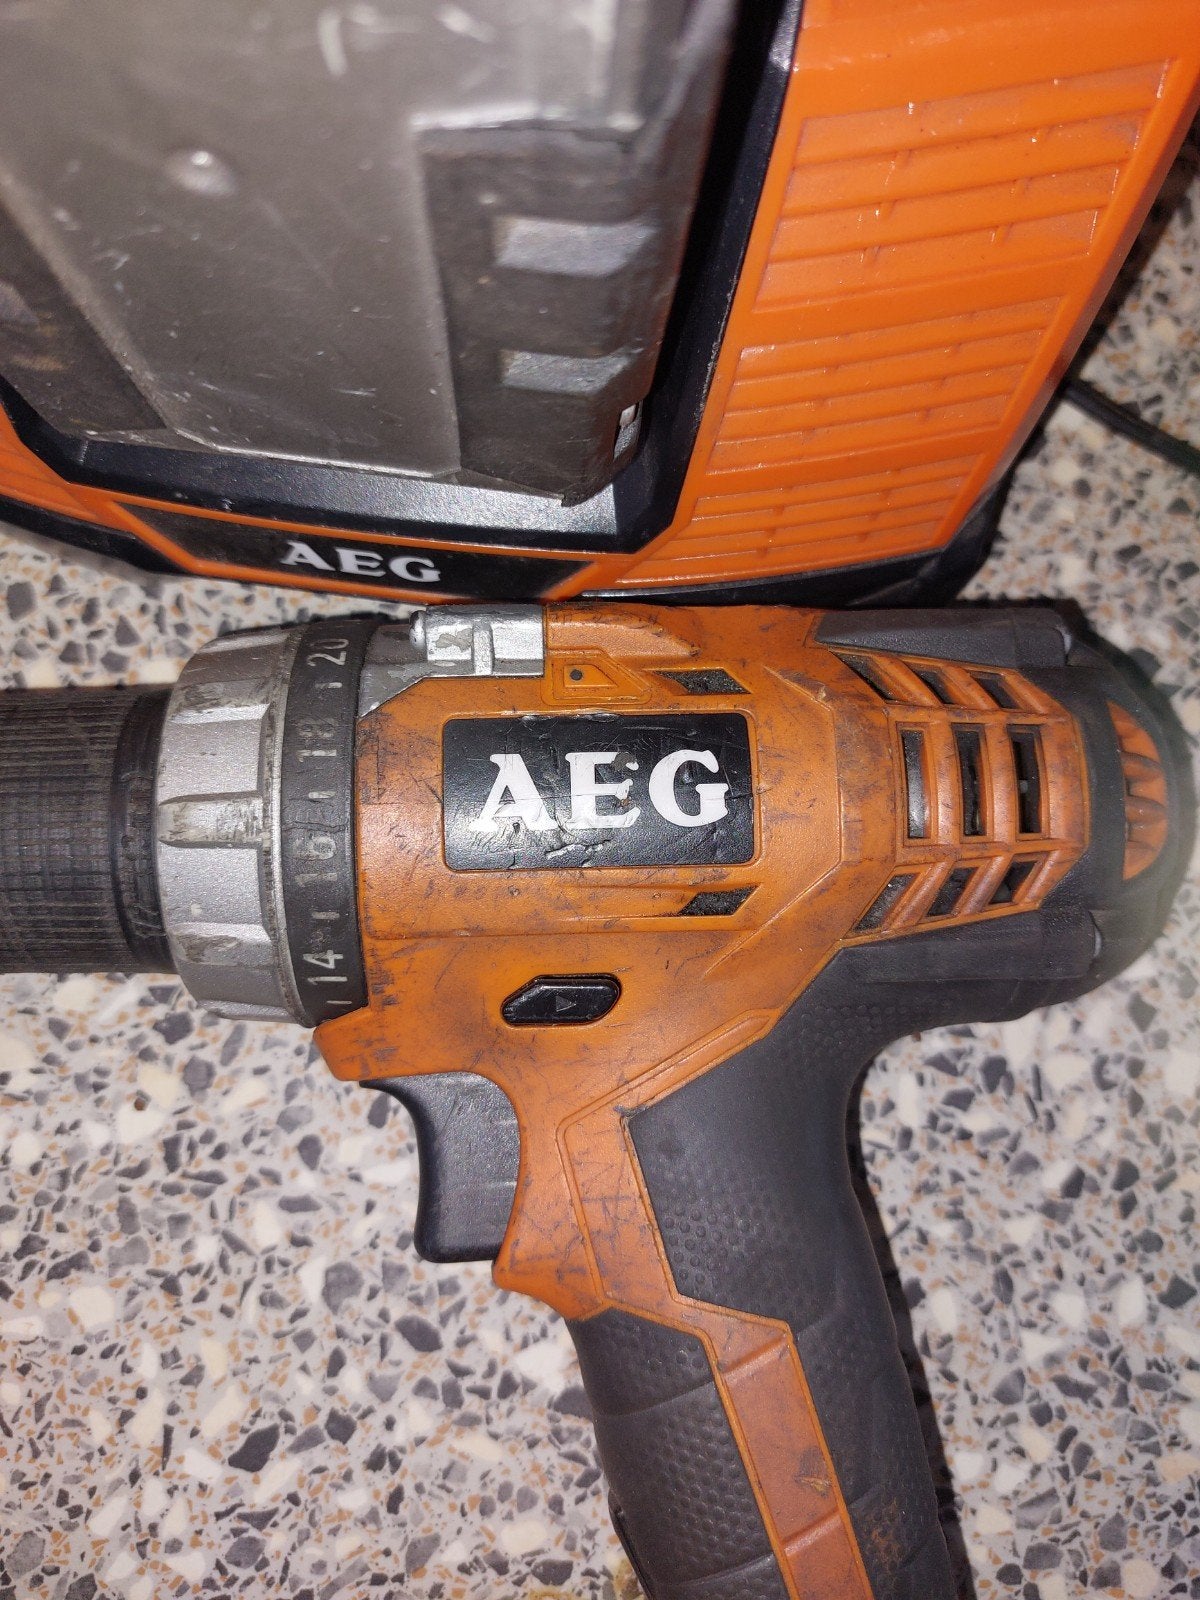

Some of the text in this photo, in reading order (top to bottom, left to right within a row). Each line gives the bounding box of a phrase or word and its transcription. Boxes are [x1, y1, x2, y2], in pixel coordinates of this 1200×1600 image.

[280, 539, 441, 582] AEG
[306, 638, 349, 667] 20
[468, 749, 729, 831] AEG
[302, 949, 348, 985] 14
